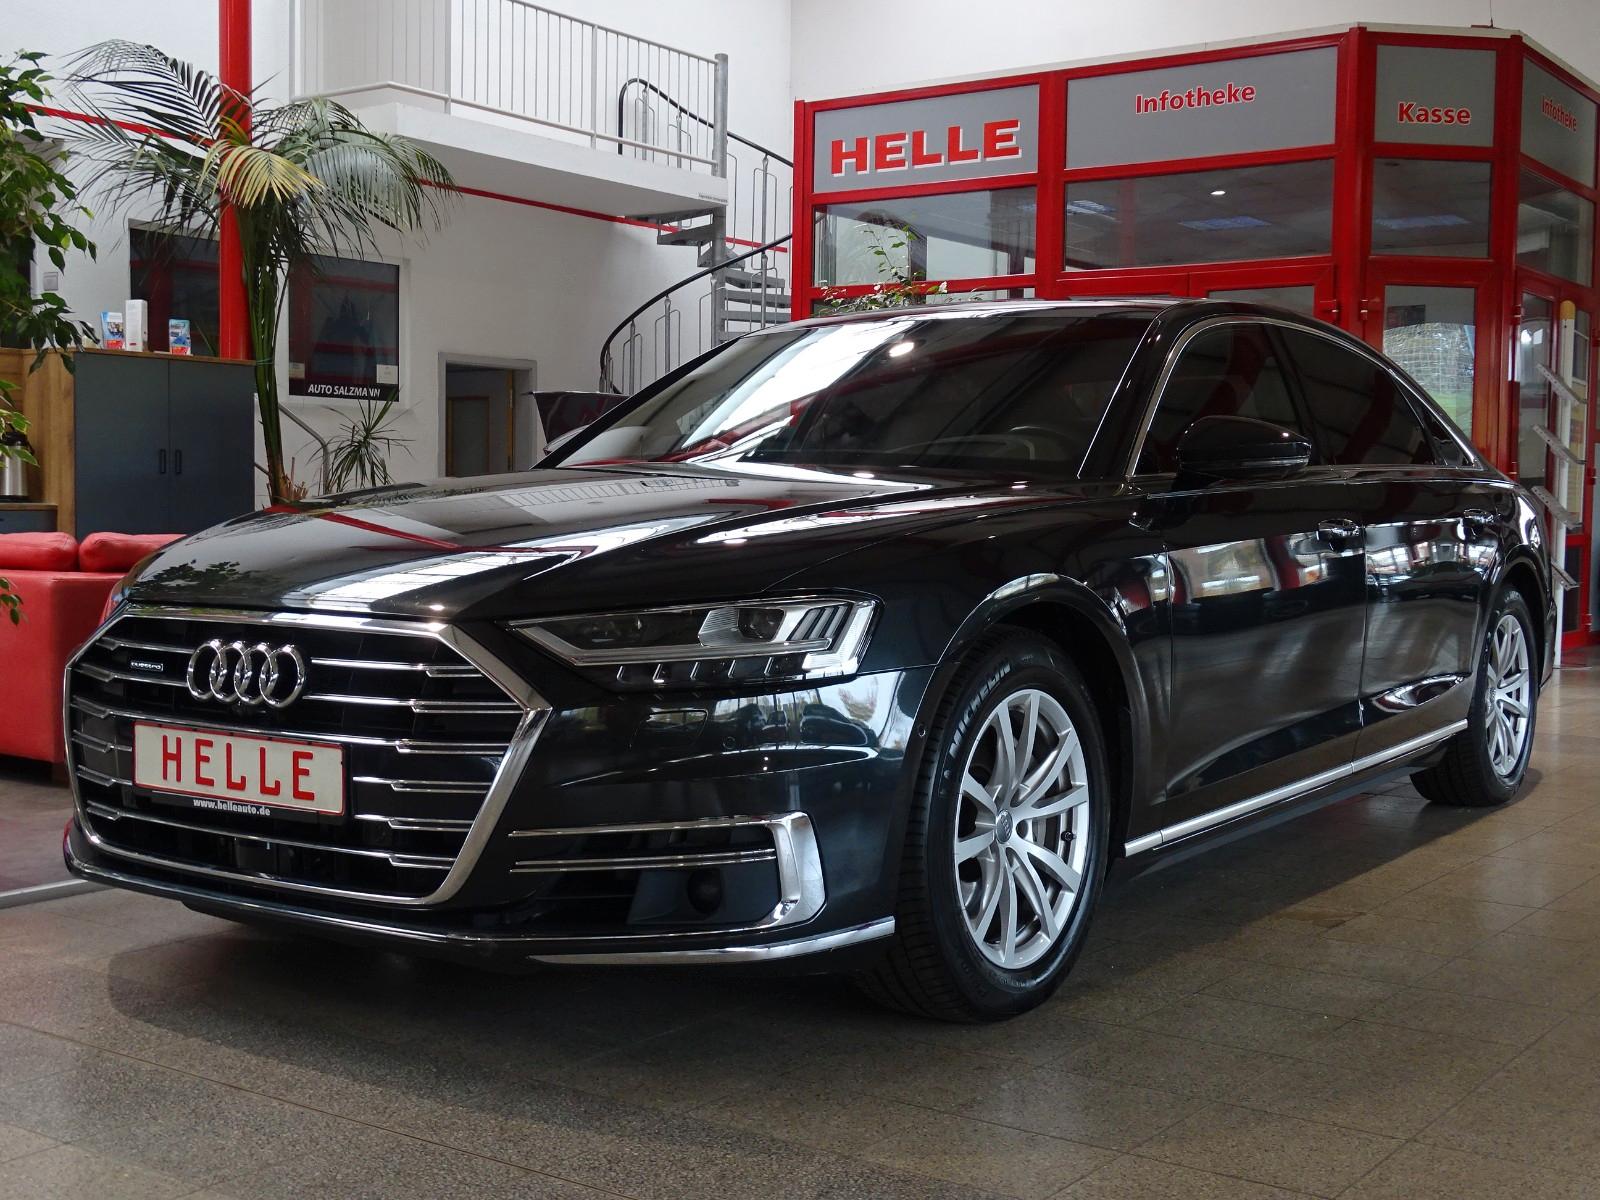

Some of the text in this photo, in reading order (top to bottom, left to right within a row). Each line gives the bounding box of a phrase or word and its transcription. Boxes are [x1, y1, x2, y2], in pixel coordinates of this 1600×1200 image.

[1135, 82, 1257, 115] Infotheke
[1397, 101, 1472, 126] Kasse
[1541, 95, 1577, 132] Infotheke
[831, 119, 1022, 176] HELLE
[308, 384, 381, 398] AUTO SALZMANN
[949, 663, 1011, 758] MICHELIN
[162, 734, 316, 802] HELLE
[193, 797, 271, 817] www.helleauto.de
